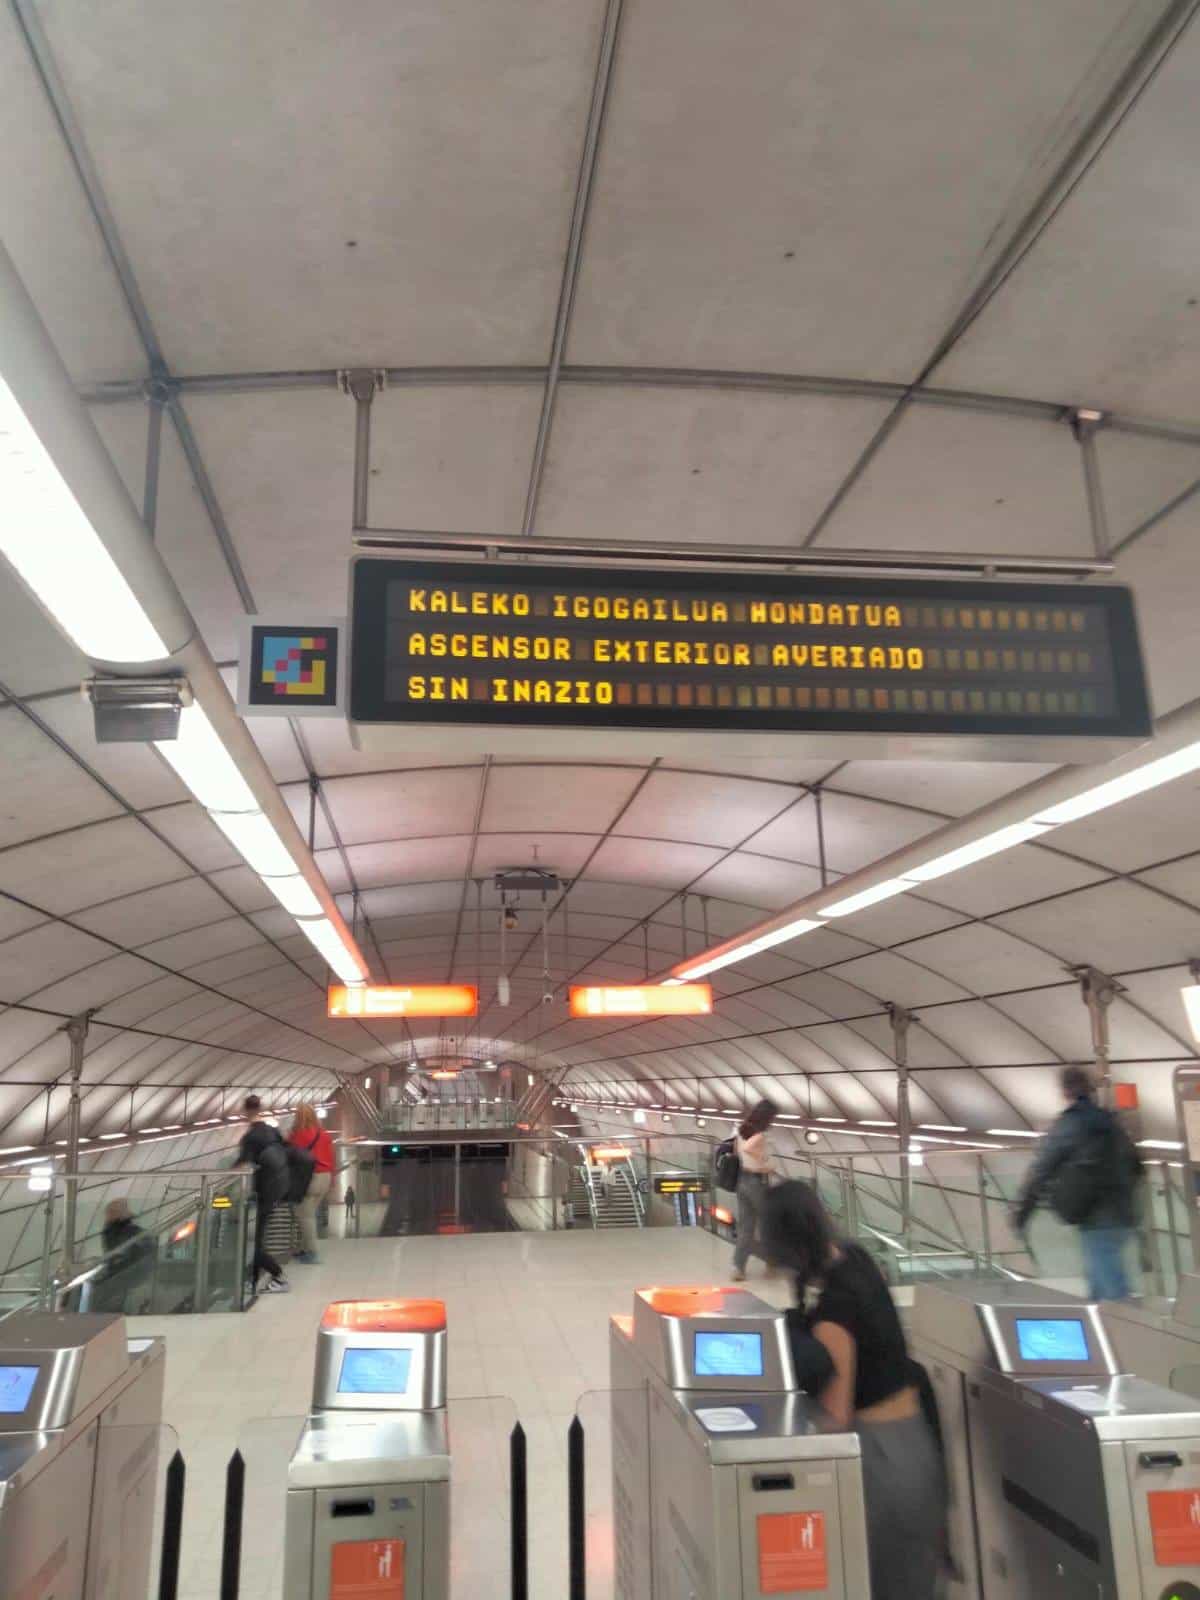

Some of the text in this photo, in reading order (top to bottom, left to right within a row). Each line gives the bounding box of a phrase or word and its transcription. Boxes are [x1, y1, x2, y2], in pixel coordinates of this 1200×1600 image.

[408, 589, 529, 616] KALEKO
[552, 595, 728, 622] IGOGAILUA
[408, 633, 923, 670] ASCENSOR EXTERIOR AVERIADO
[407, 676, 613, 704] SIN INAZIO
